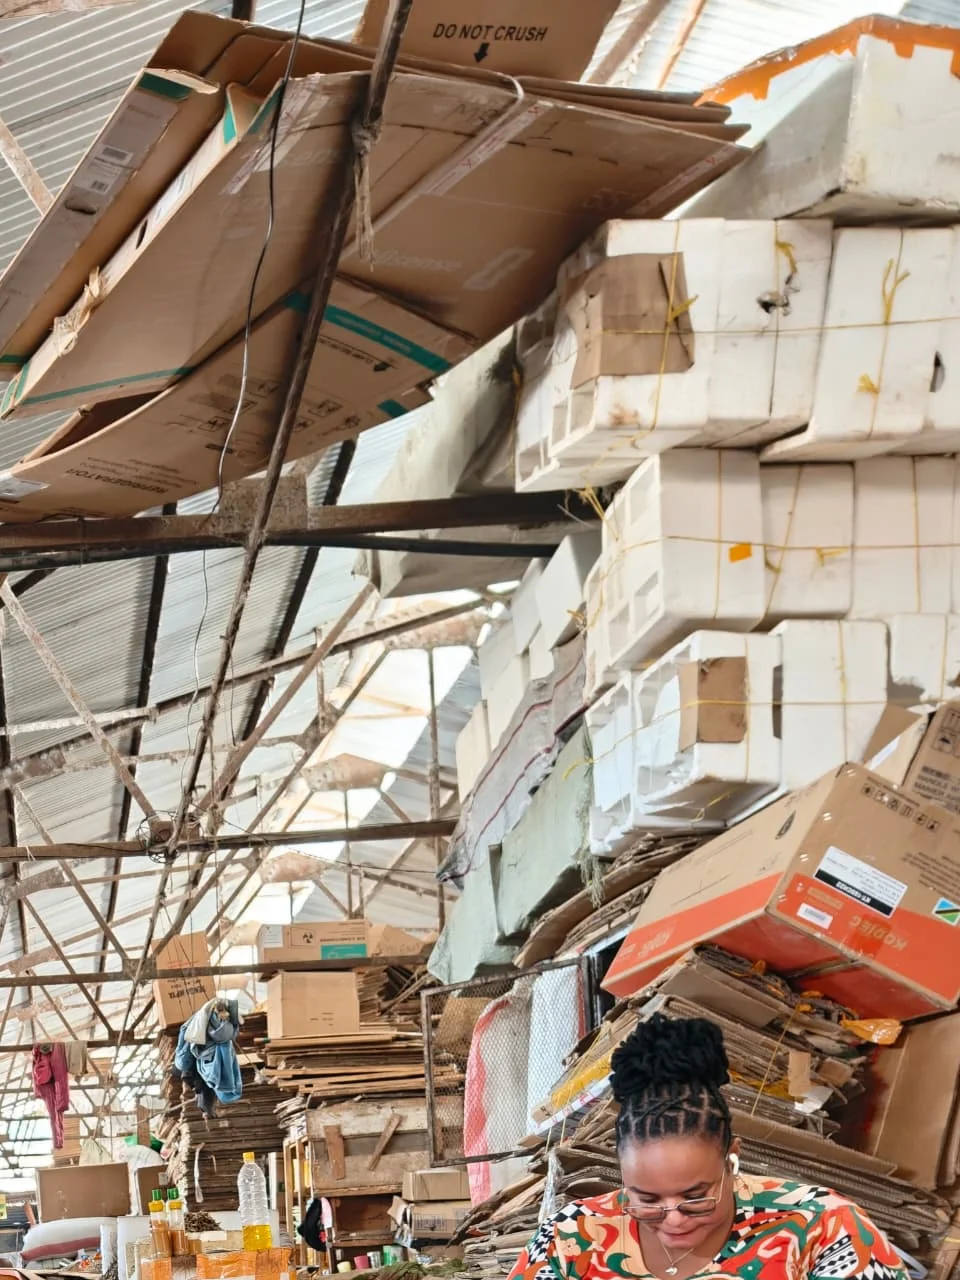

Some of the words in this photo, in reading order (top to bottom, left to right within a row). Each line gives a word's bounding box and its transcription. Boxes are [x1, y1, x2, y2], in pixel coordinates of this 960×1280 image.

[432, 23, 457, 39] DO
[458, 24, 494, 40] NOT
[494, 26, 548, 41] CRUSH
